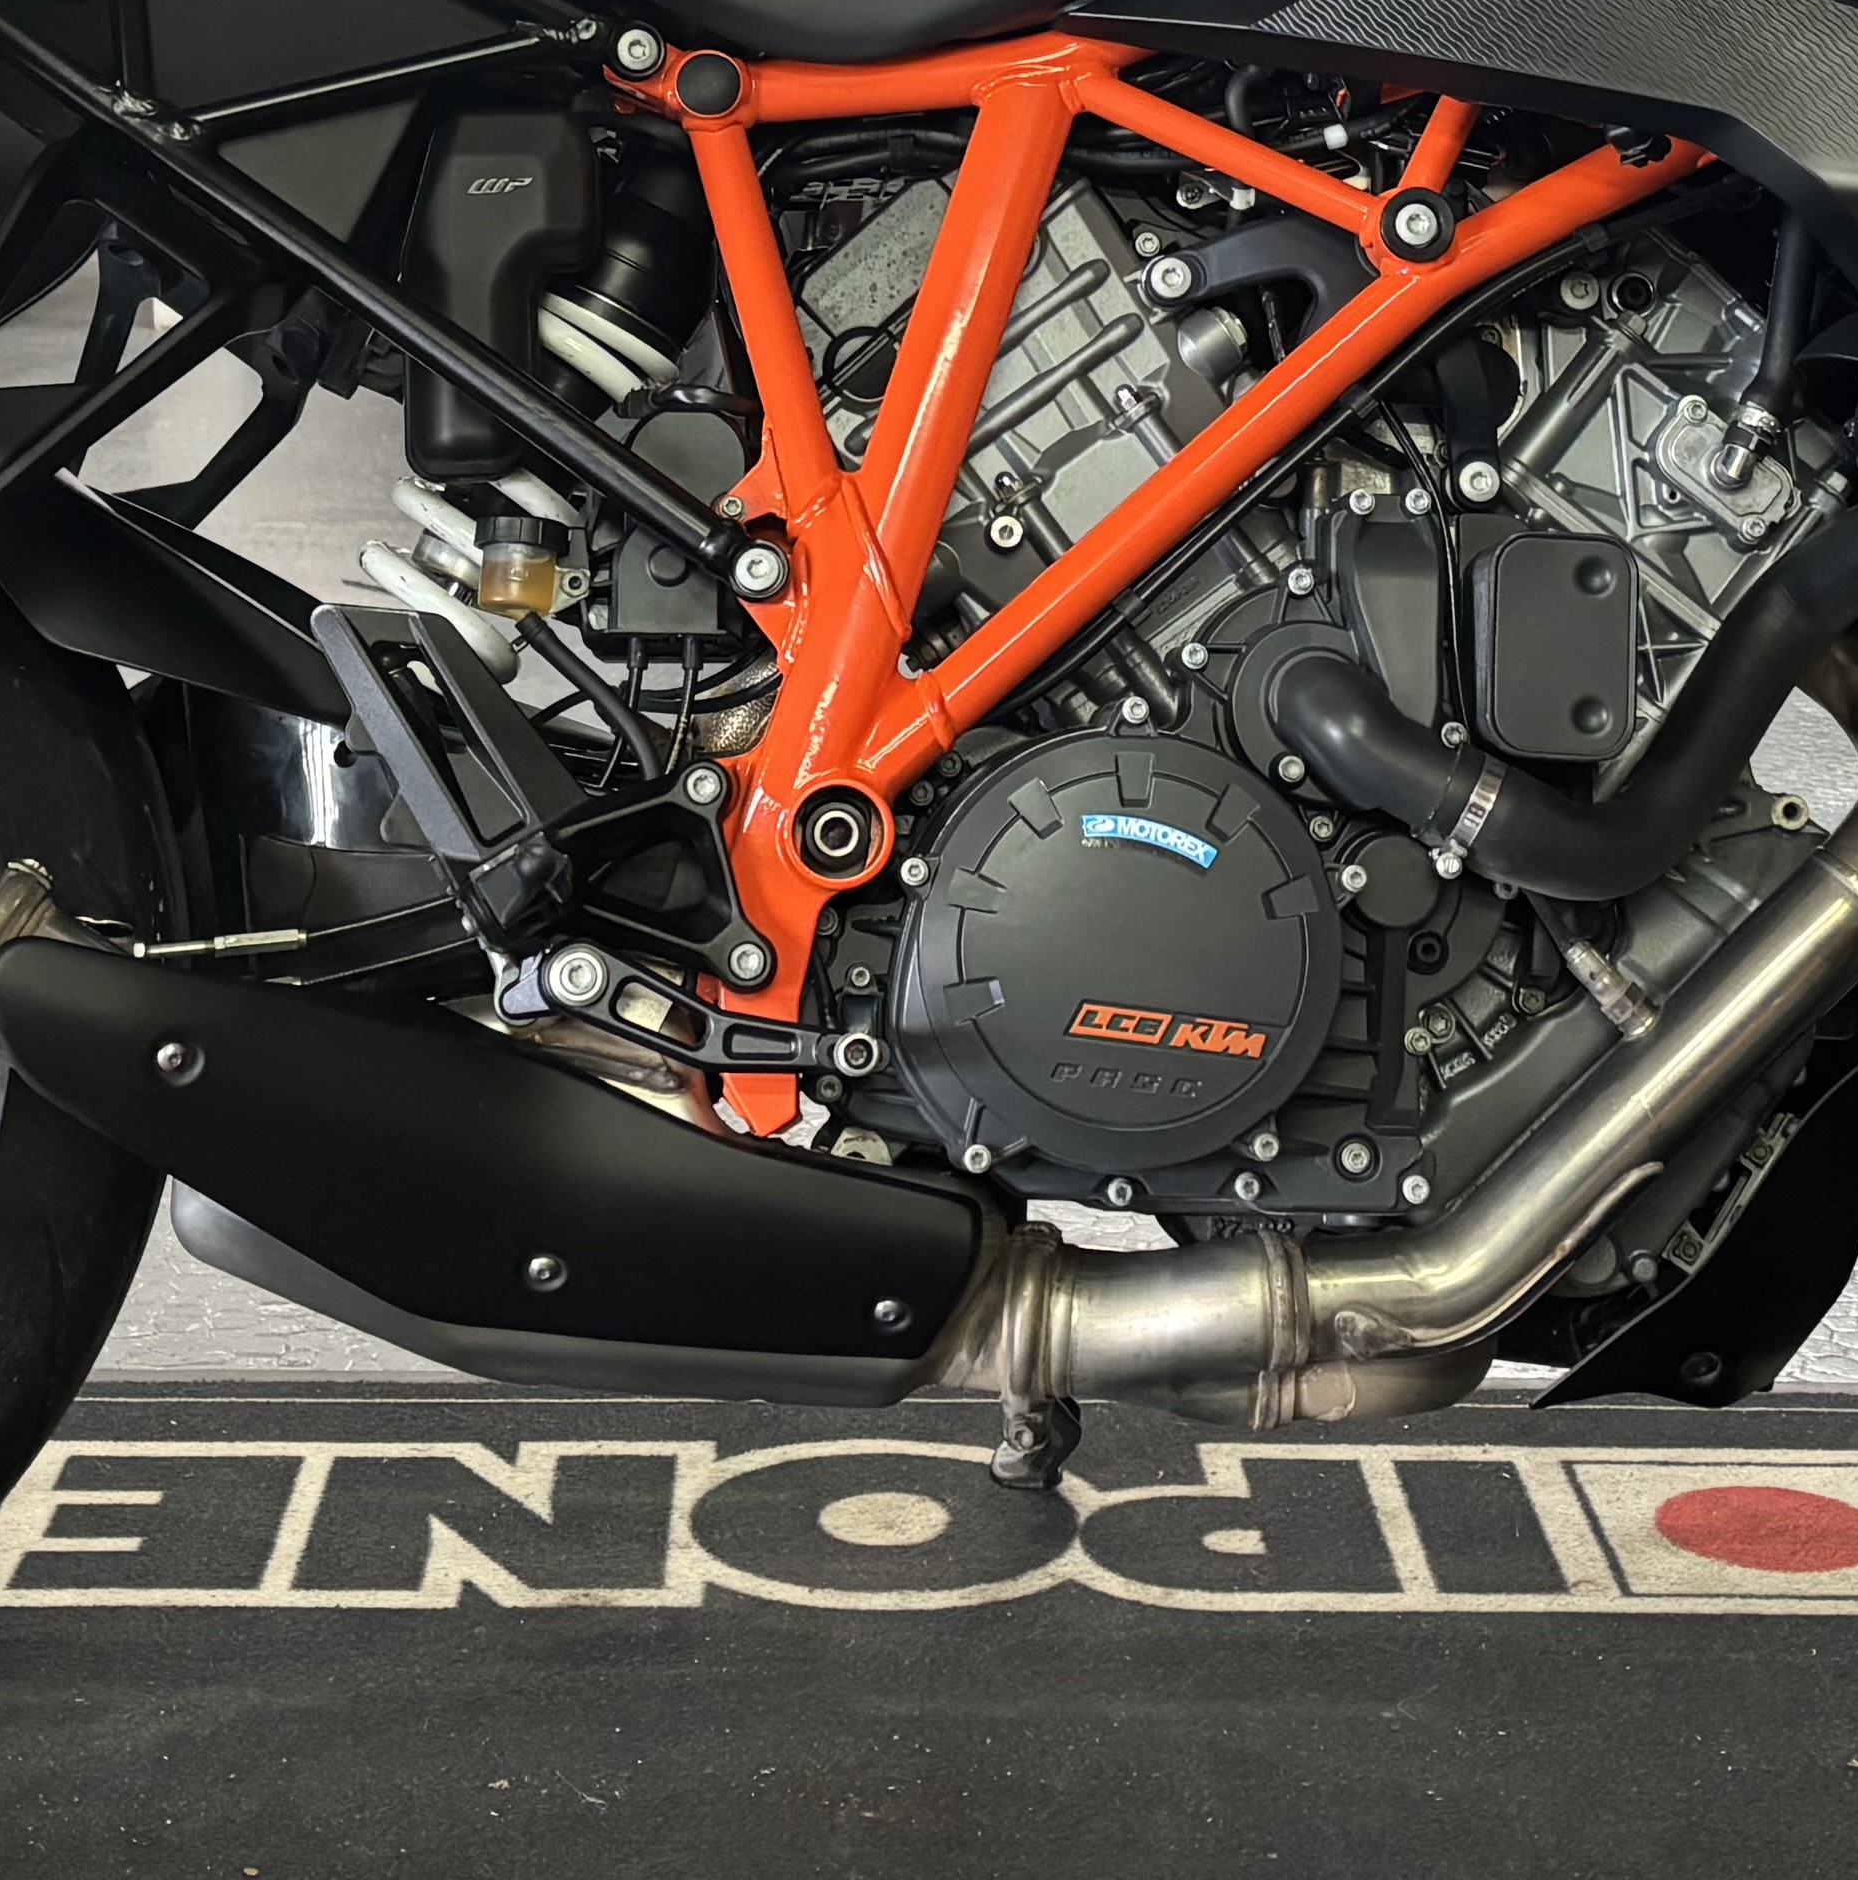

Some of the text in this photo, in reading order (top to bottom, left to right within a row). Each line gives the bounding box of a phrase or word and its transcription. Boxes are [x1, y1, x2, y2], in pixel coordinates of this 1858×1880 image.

[467, 176, 533, 195] WP
[1116, 817, 1212, 864] MOTOREX
[1169, 1018, 1266, 1059] KTM
